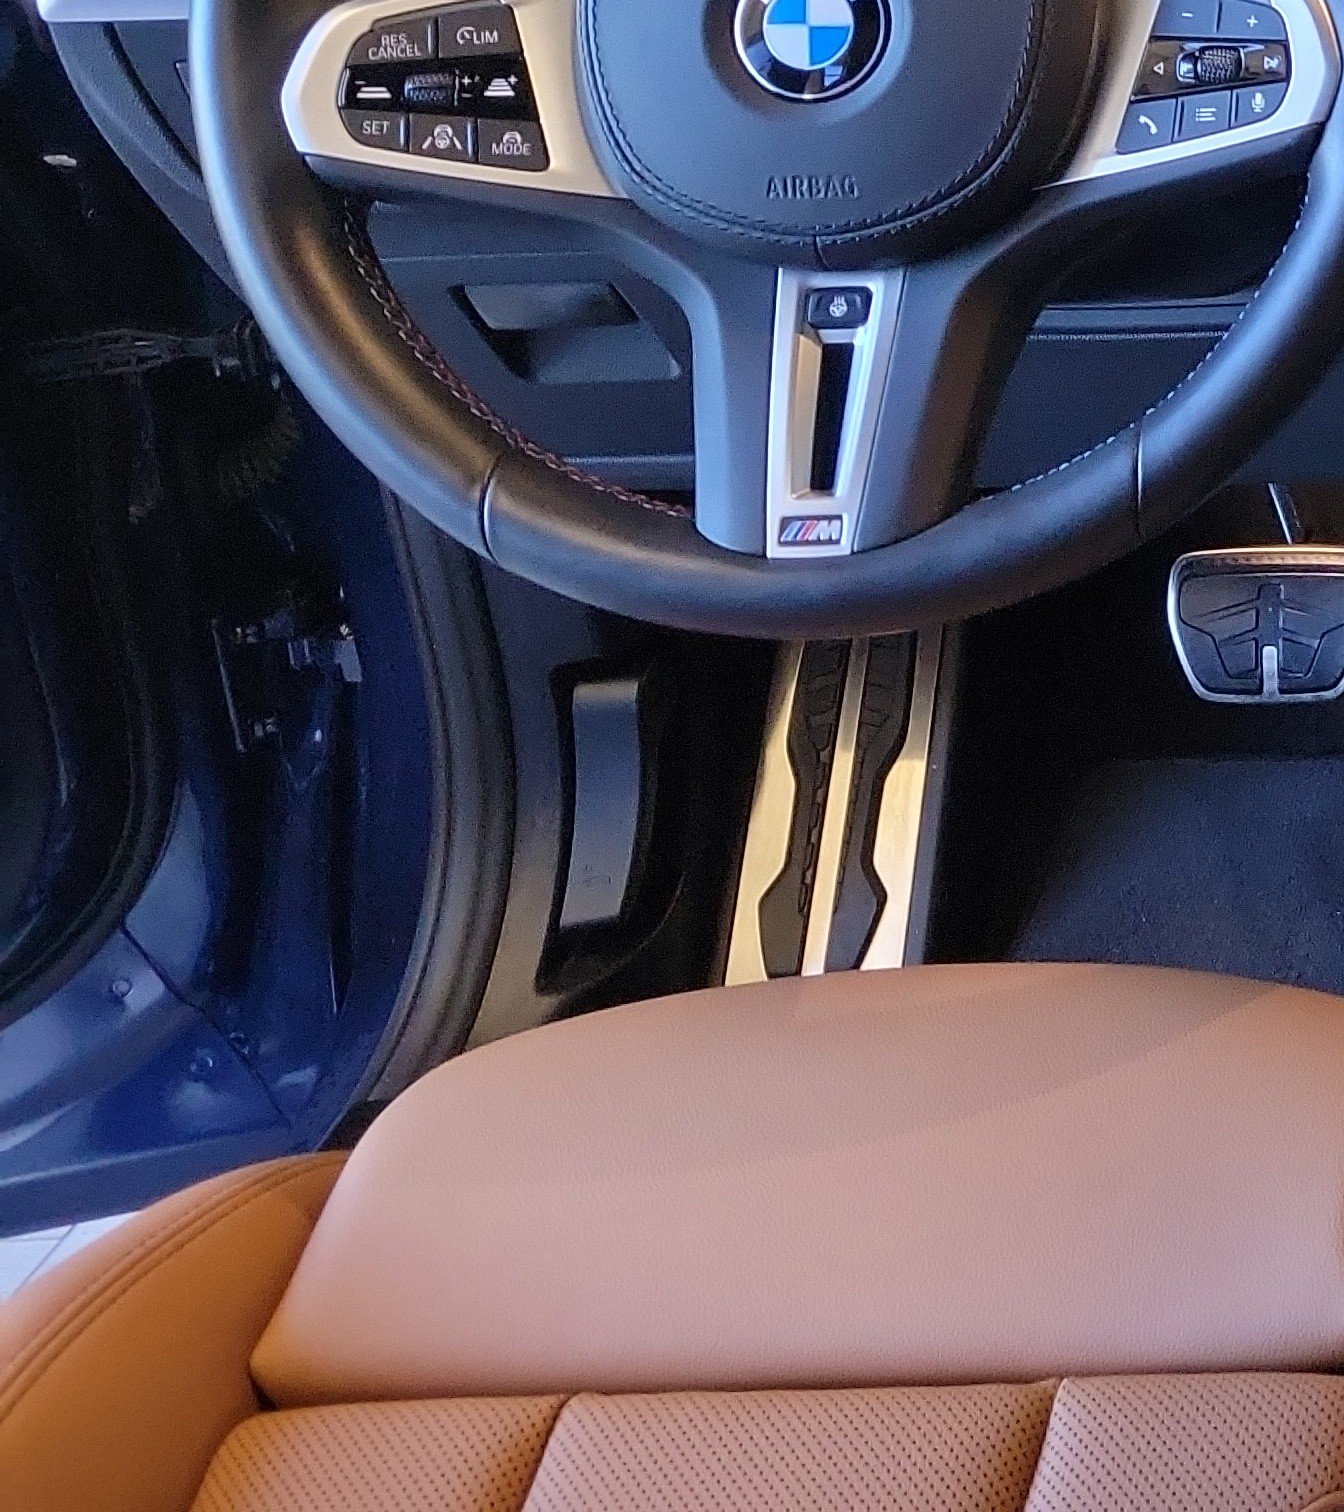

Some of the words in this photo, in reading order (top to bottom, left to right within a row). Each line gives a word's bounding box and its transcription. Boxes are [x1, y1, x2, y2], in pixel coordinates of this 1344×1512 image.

[381, 33, 407, 47] RES
[473, 30, 499, 44] LIM
[368, 42, 421, 60] CANCEL
[362, 121, 390, 135] SET
[491, 142, 532, 156] MODE
[766, 175, 860, 200] AIRBAG
